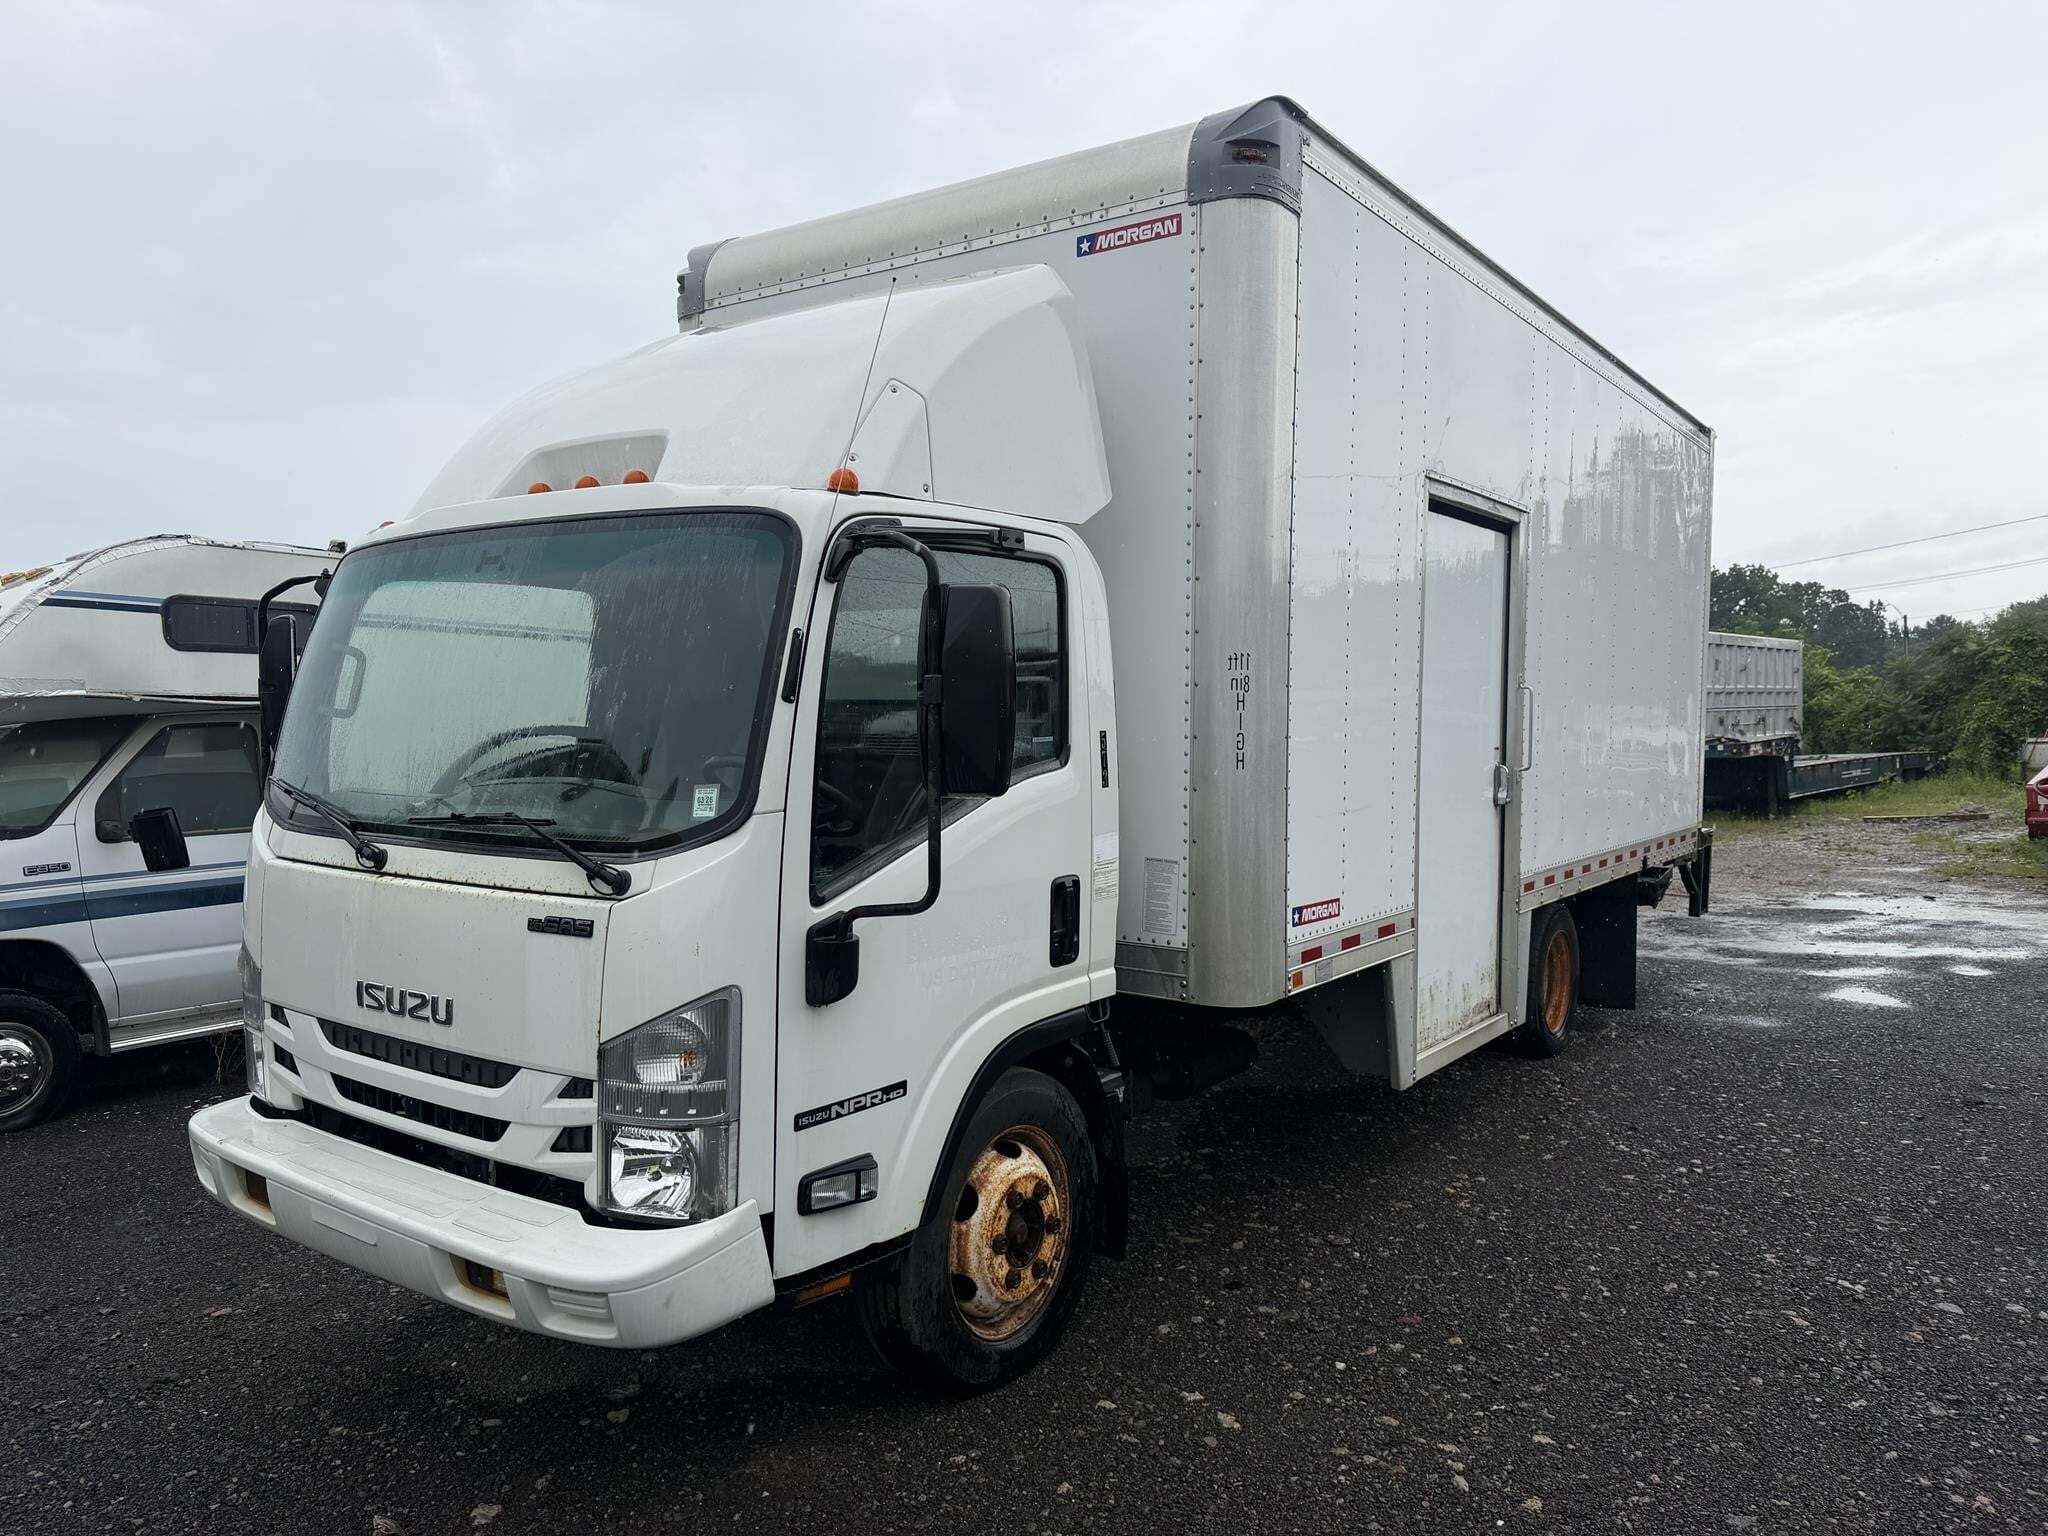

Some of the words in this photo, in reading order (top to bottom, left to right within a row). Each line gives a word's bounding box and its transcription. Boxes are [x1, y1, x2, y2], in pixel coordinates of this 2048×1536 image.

[1094, 217, 1178, 250] MORGAN
[23, 862, 71, 876] E350
[1301, 901, 1339, 923] MORGAN
[543, 916, 593, 936] GAS
[356, 979, 454, 1027] ISUZU
[799, 1110, 830, 1127] ISUZU
